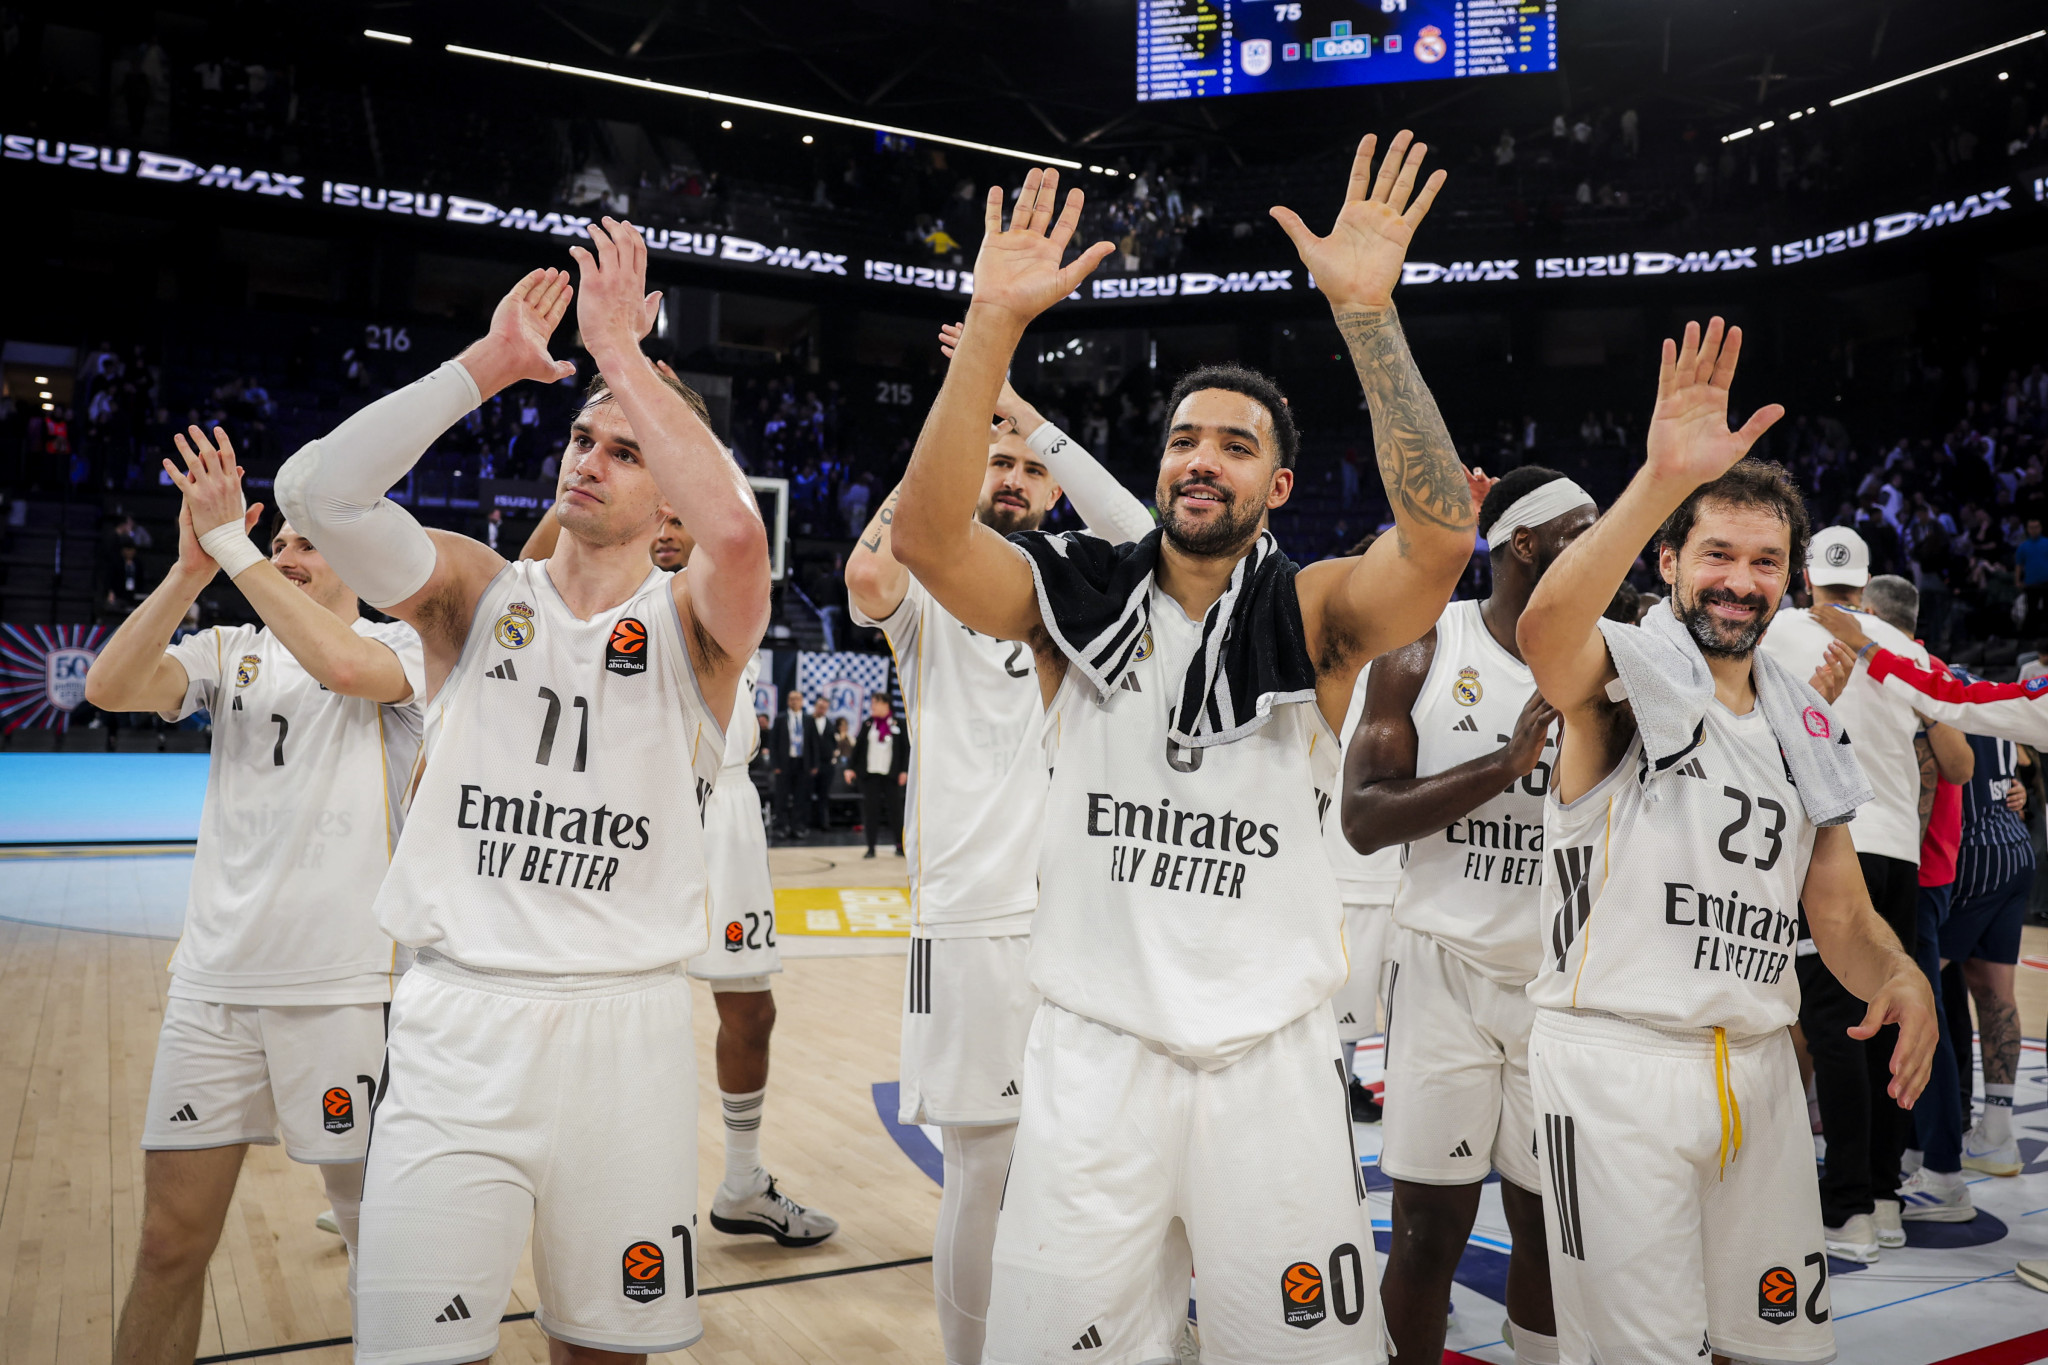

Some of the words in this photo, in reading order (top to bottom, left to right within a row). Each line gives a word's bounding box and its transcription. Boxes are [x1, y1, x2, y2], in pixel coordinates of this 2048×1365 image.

[1273, 3, 1302, 22] 75
[1323, 38, 1365, 56] 0:00
[0, 134, 131, 174] SUZU
[322, 180, 442, 218] ISUZU
[632, 224, 717, 257] UZU
[1771, 221, 1869, 267] ISUZU
[864, 259, 958, 291] ISUZU
[1535, 252, 1630, 279] ISUZU
[1092, 274, 1178, 299] ISUZU
[367, 325, 410, 351] 216
[876, 381, 912, 405] 215
[56, 656, 89, 679] 50
[457, 784, 650, 851] Emirates
[1087, 792, 1279, 858] Emirates
[1718, 785, 1787, 872] 23
[477, 839, 516, 878] FLY
[520, 845, 619, 892] BETTER
[1111, 845, 1147, 882] FLY
[1150, 852, 1246, 899] BETTER
[1464, 852, 1496, 882] FLY
[745, 911, 776, 950] 22
[672, 1213, 698, 1299] 1
[641, 1287, 663, 1295] dhabi
[1329, 1242, 1364, 1326] 0
[1804, 1251, 1829, 1325] 2
[1288, 1314, 1303, 1322] abu
[1303, 1310, 1324, 1321] dhabi
[1776, 1310, 1795, 1318] dhabi
